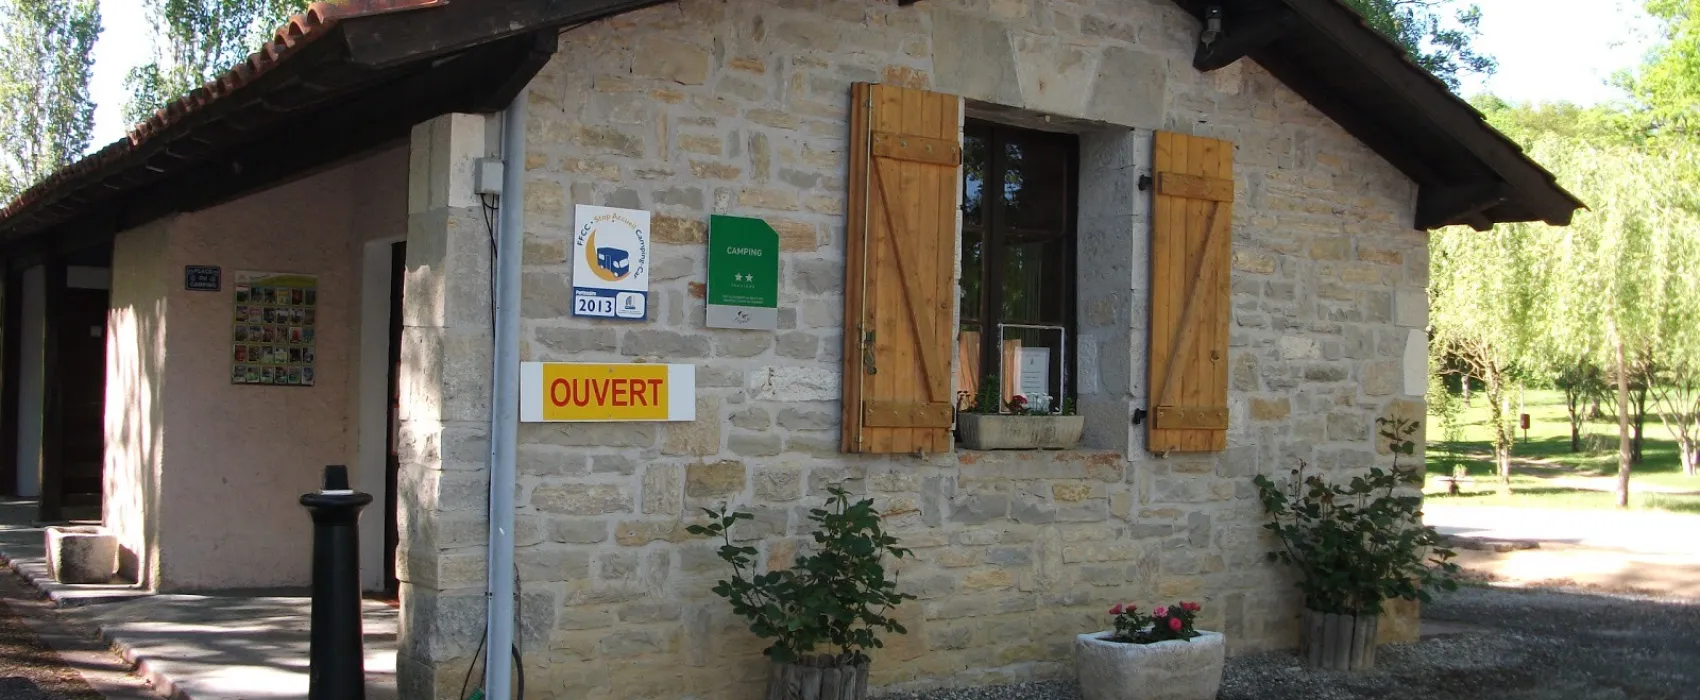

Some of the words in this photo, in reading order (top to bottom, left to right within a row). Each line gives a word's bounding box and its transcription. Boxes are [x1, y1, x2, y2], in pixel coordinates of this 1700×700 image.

[577, 223, 591, 246] FFCC
[594, 214, 611, 223] Stop
[612, 212, 637, 230] Accueil
[633, 229, 646, 279] Camping-Car
[726, 246, 763, 257] CAMPING
[579, 298, 612, 313] 2013
[550, 377, 663, 407] OUVERT
